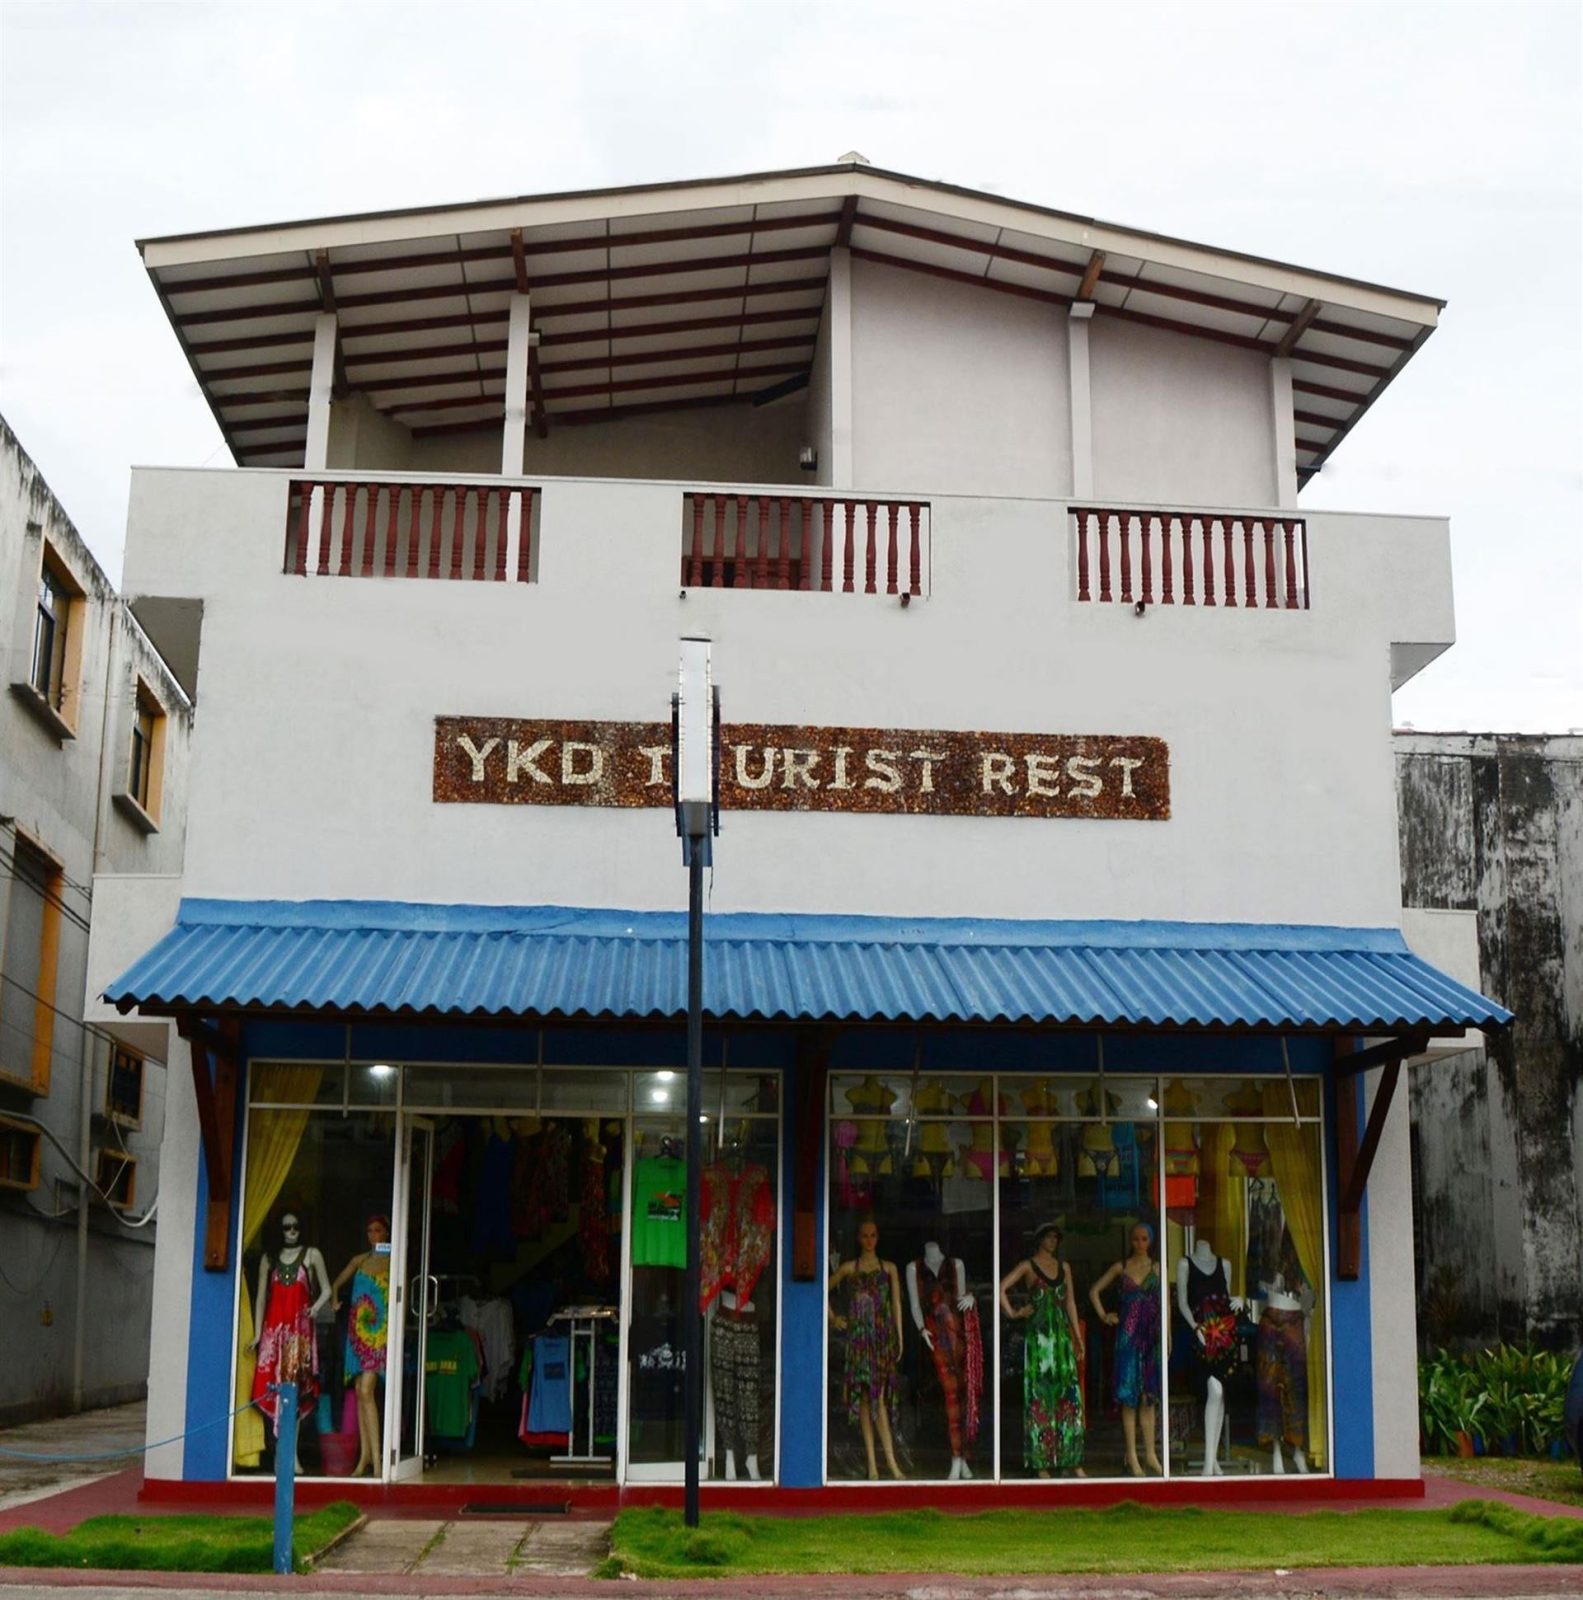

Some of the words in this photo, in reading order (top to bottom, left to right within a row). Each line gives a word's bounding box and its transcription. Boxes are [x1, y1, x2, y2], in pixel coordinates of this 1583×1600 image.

[457, 734, 602, 785] YKD
[638, 744, 946, 794] TURIST
[981, 752, 1146, 798] REST
